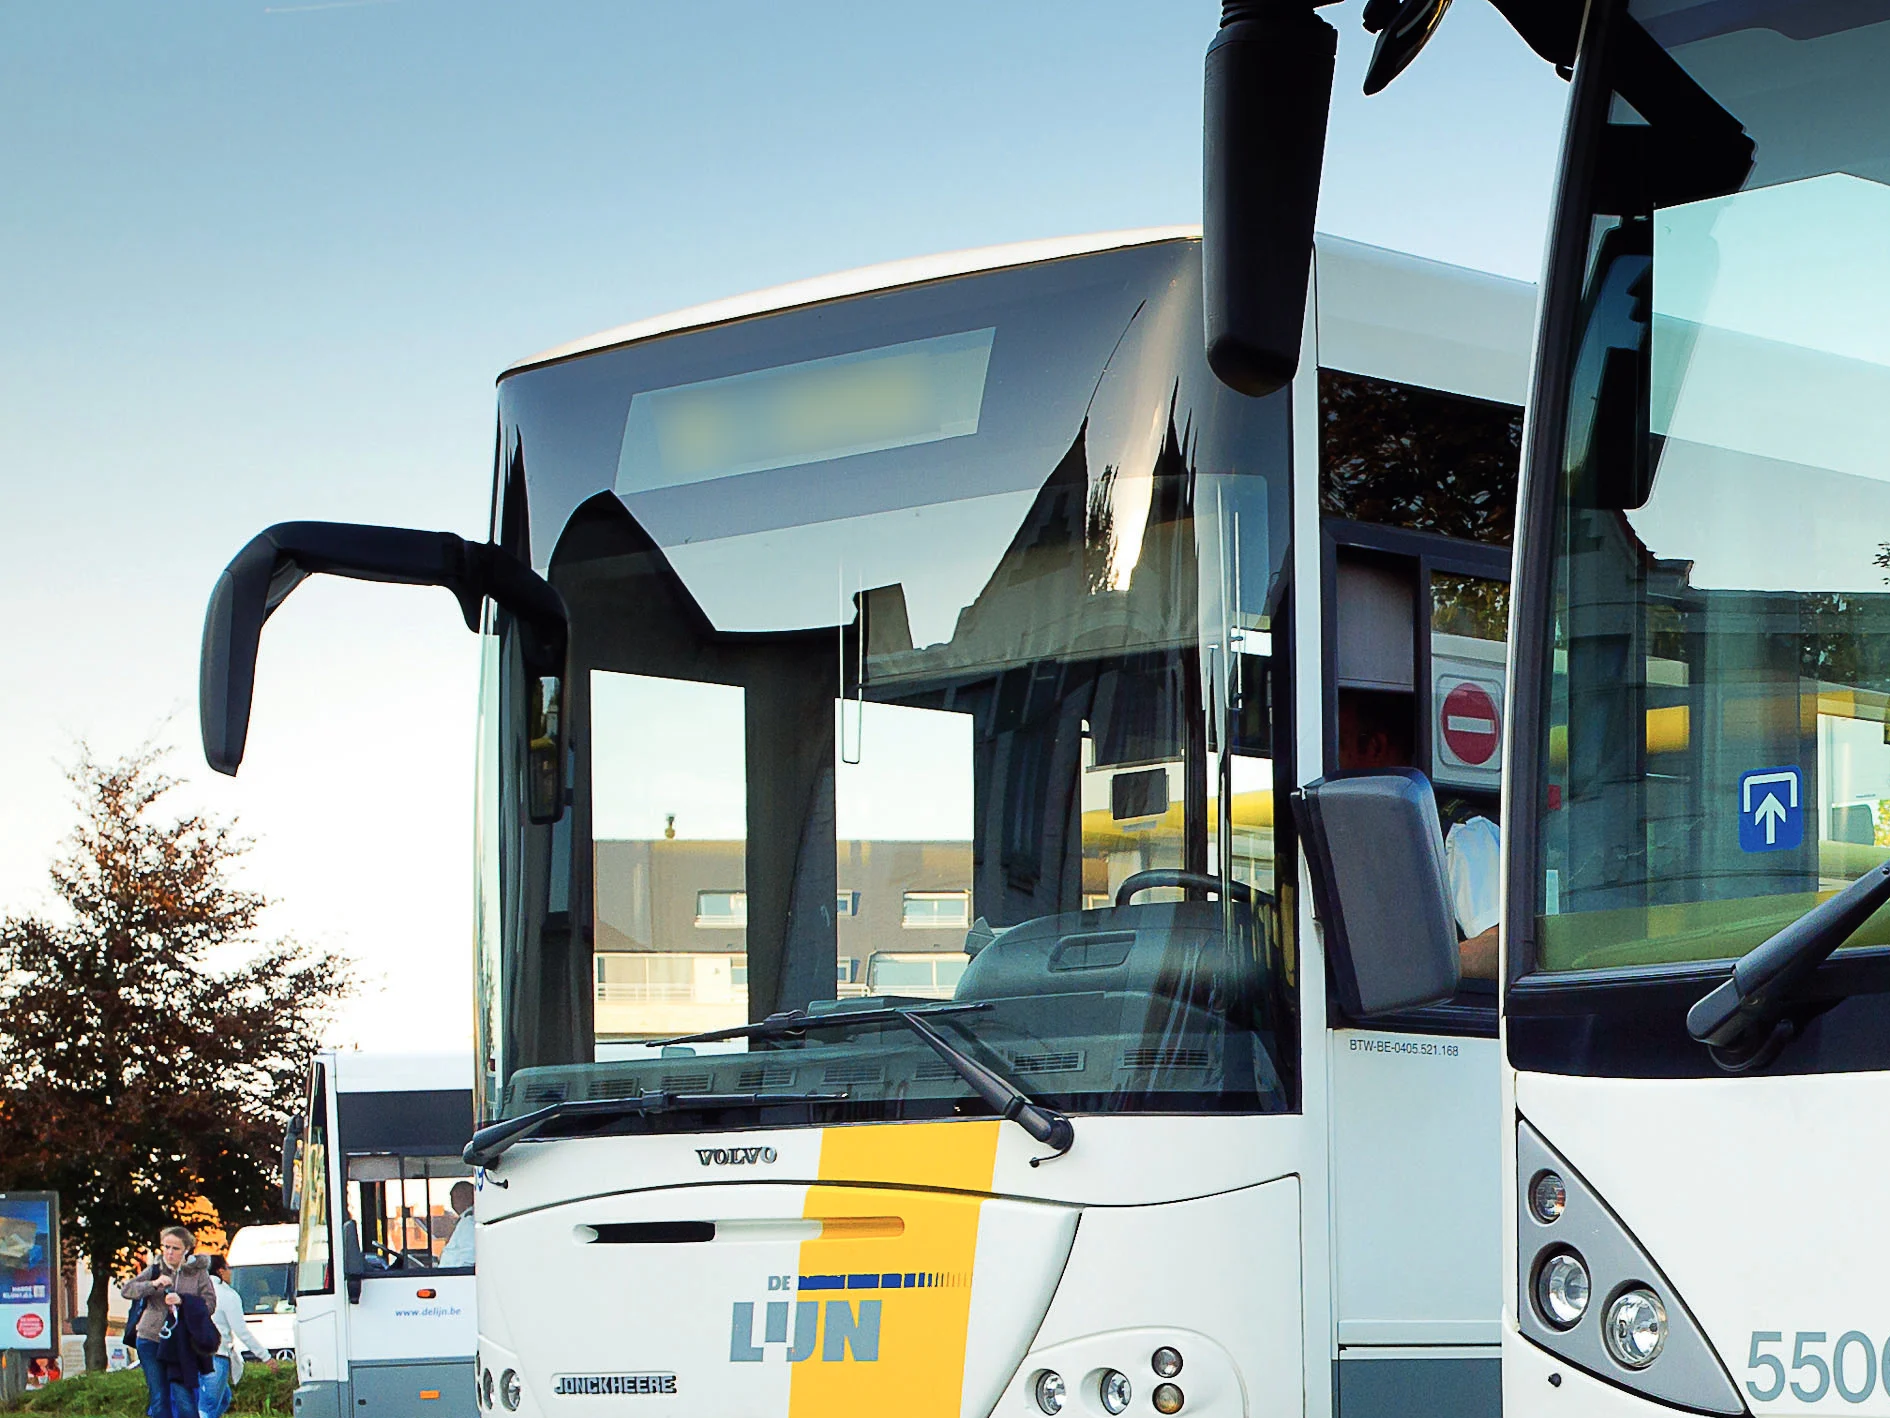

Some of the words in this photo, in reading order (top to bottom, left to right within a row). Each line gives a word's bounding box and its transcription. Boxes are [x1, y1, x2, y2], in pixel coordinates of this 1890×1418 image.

[1349, 1039, 1460, 1057] BTW-BE-0405.521.168
[694, 1146, 778, 1167] VOLVO
[767, 1275, 792, 1291] DE
[394, 1306, 462, 1318] www.delijn.be
[730, 1299, 883, 1362] LIJN
[553, 1374, 678, 1395] JONCKHEERE
